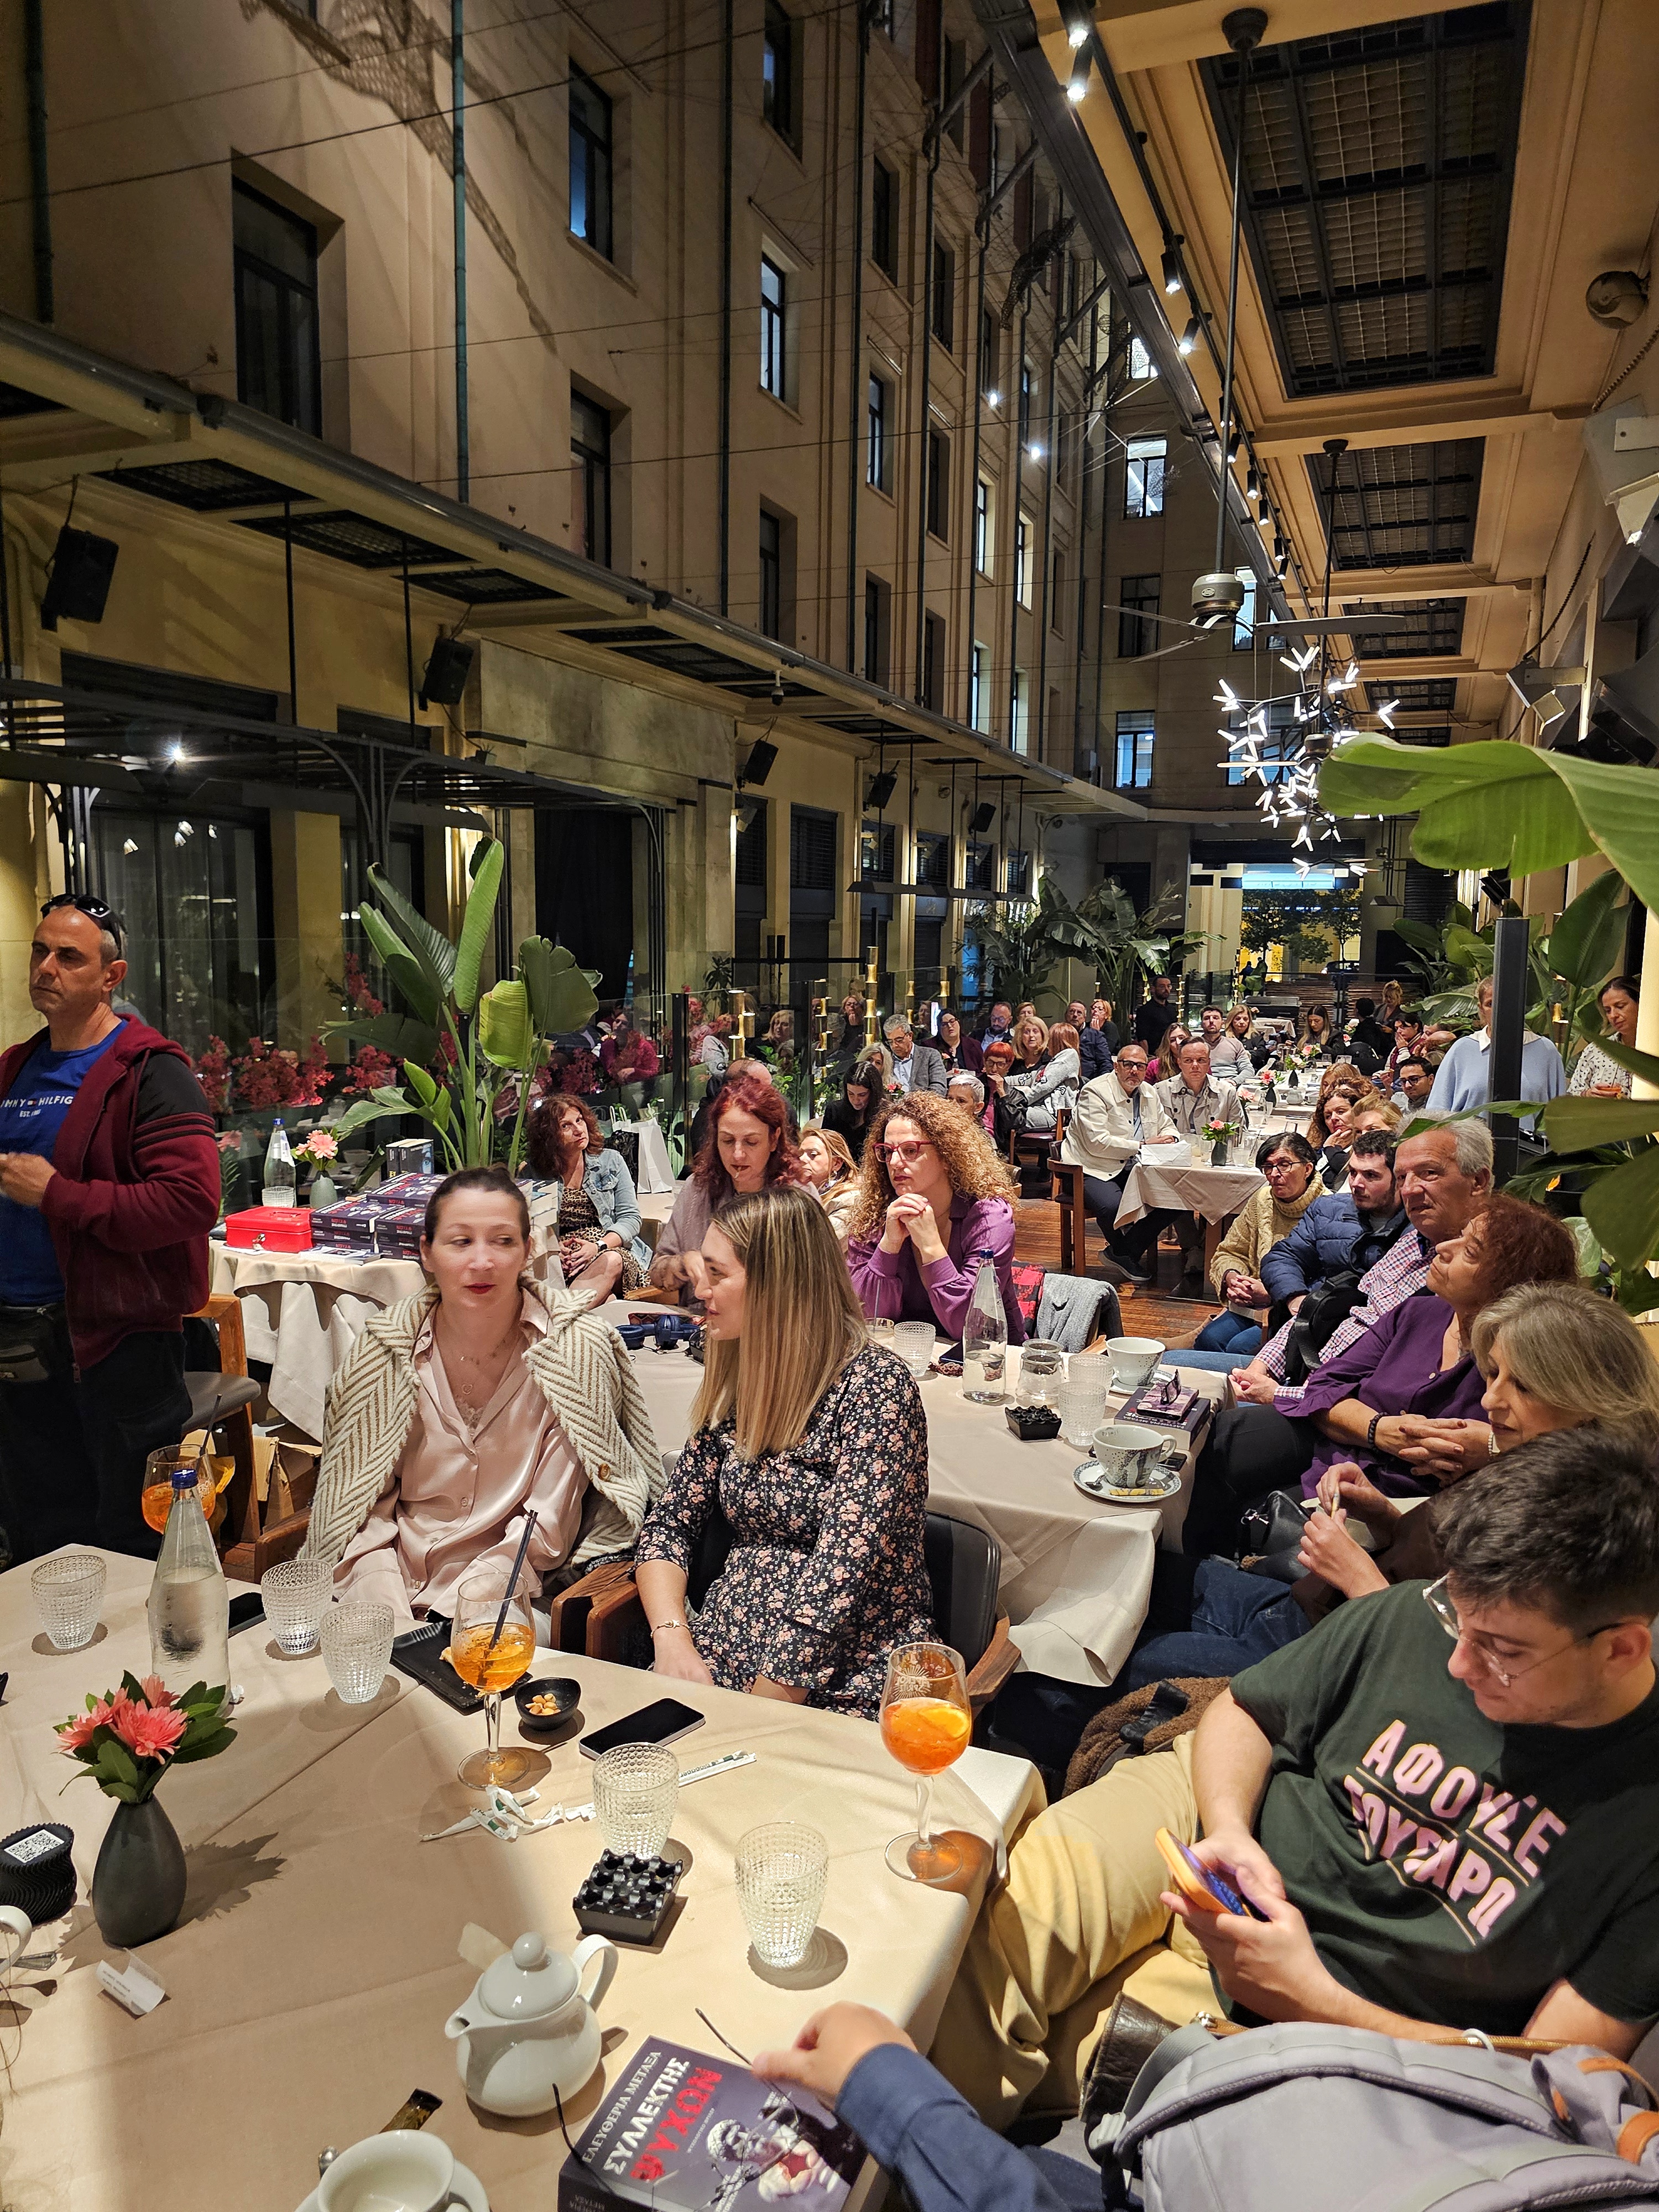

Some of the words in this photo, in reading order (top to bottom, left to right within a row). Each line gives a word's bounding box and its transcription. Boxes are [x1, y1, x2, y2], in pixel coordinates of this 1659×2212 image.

[582, 2095, 632, 2163] ΕΛΕΥΘΕΡΙΑ
[624, 2051, 662, 2096] ΜΕΤΑΞΑ
[603, 2057, 690, 2176] ΣΥΛΛΕΚΤΗΣ
[629, 2066, 723, 2182] ΨΥΧΩΝ
